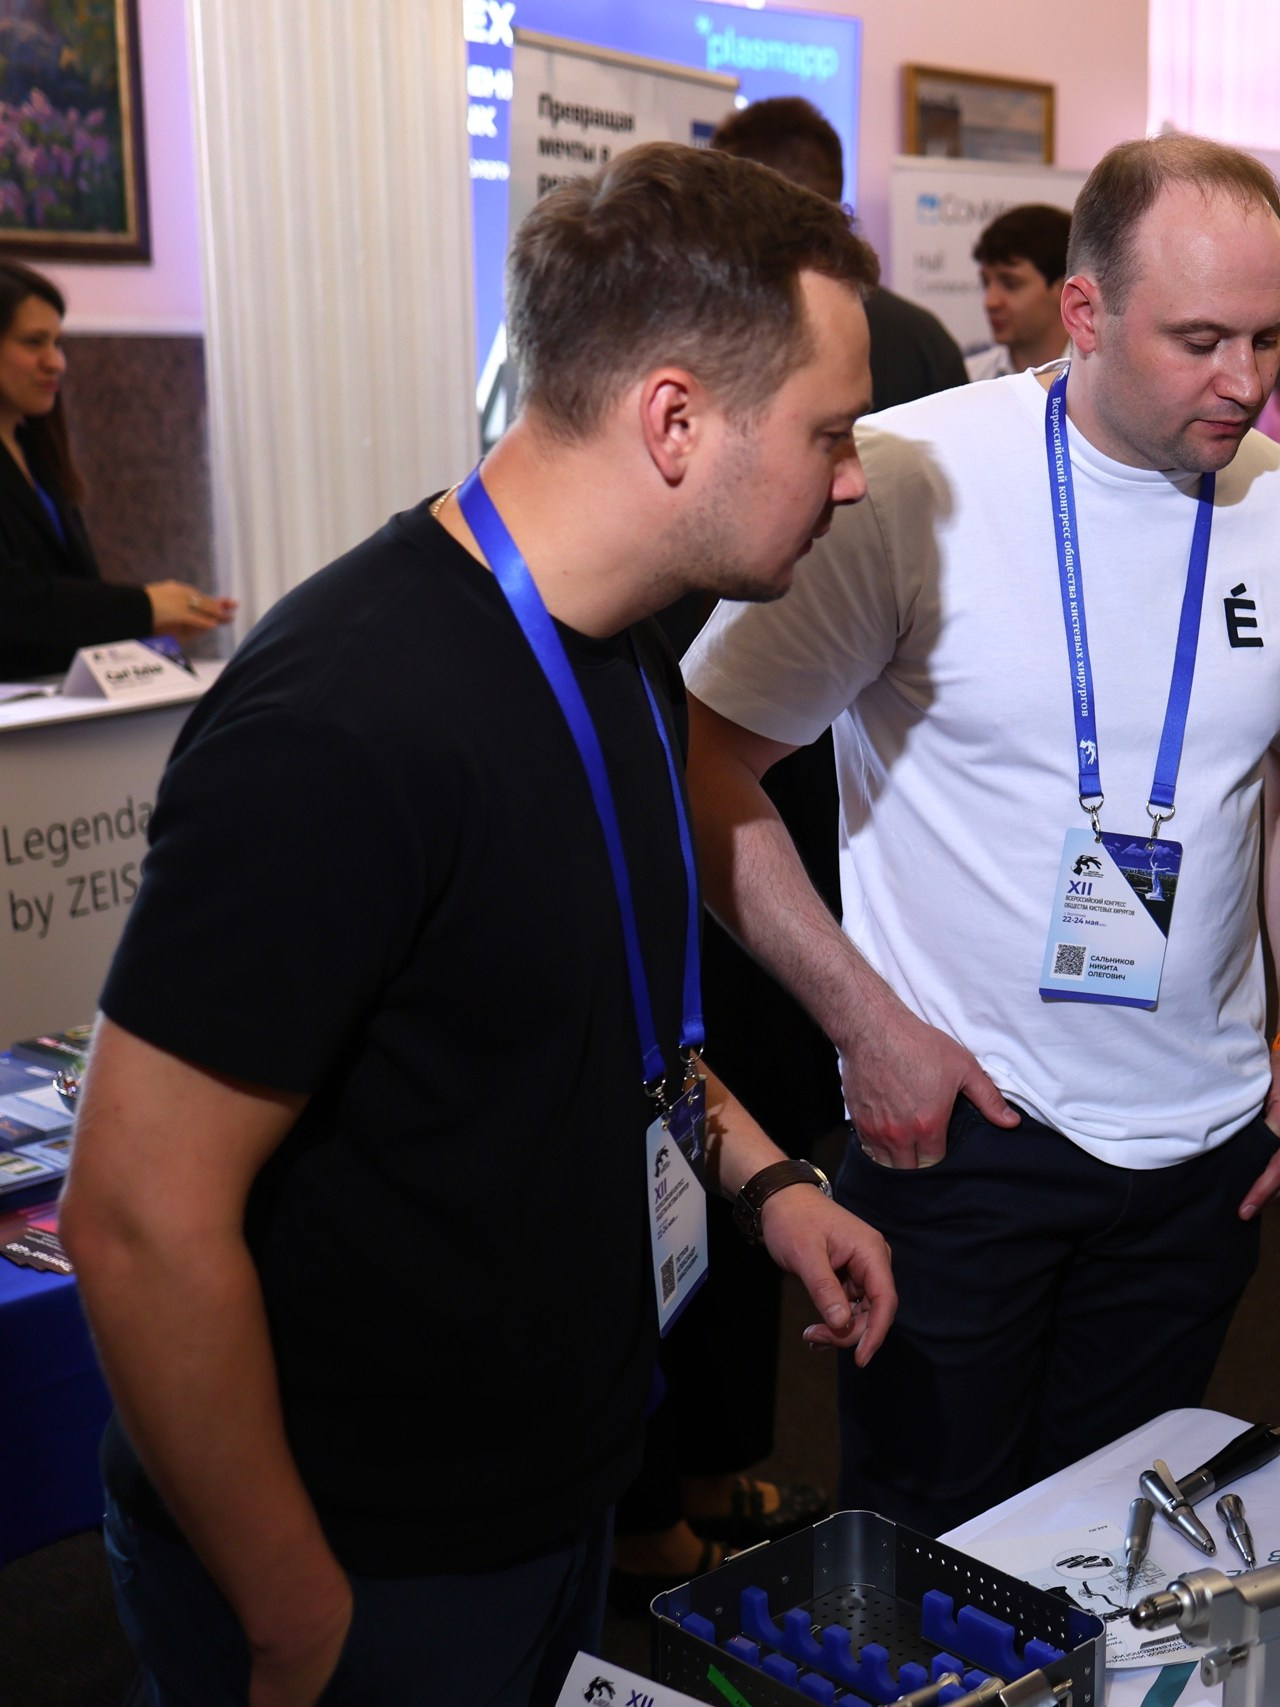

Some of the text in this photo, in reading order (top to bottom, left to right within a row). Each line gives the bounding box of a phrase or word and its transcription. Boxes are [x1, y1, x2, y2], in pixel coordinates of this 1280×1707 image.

[1050, 397, 1089, 717] Всероссийский конгресс общества кистевых хирургов
[1223, 583, 1264, 648] É
[1067, 880, 1093, 896] XII
[9, 863, 145, 939] by ZEIS
[1104, 900, 1126, 908] КОНГРЕСС
[1064, 902, 1135, 916] ОБЩЕСТВА КИСТЕВЫХ ХИРУРГОВ
[1062, 915, 1084, 924] 22-24
[1089, 963, 1118, 972] НИКИТА
[1090, 955, 1135, 966] САЛЬНИКОВ
[1088, 970, 1126, 980] ОЛЕГОВИЧ
[625, 1689, 655, 1707] XII
